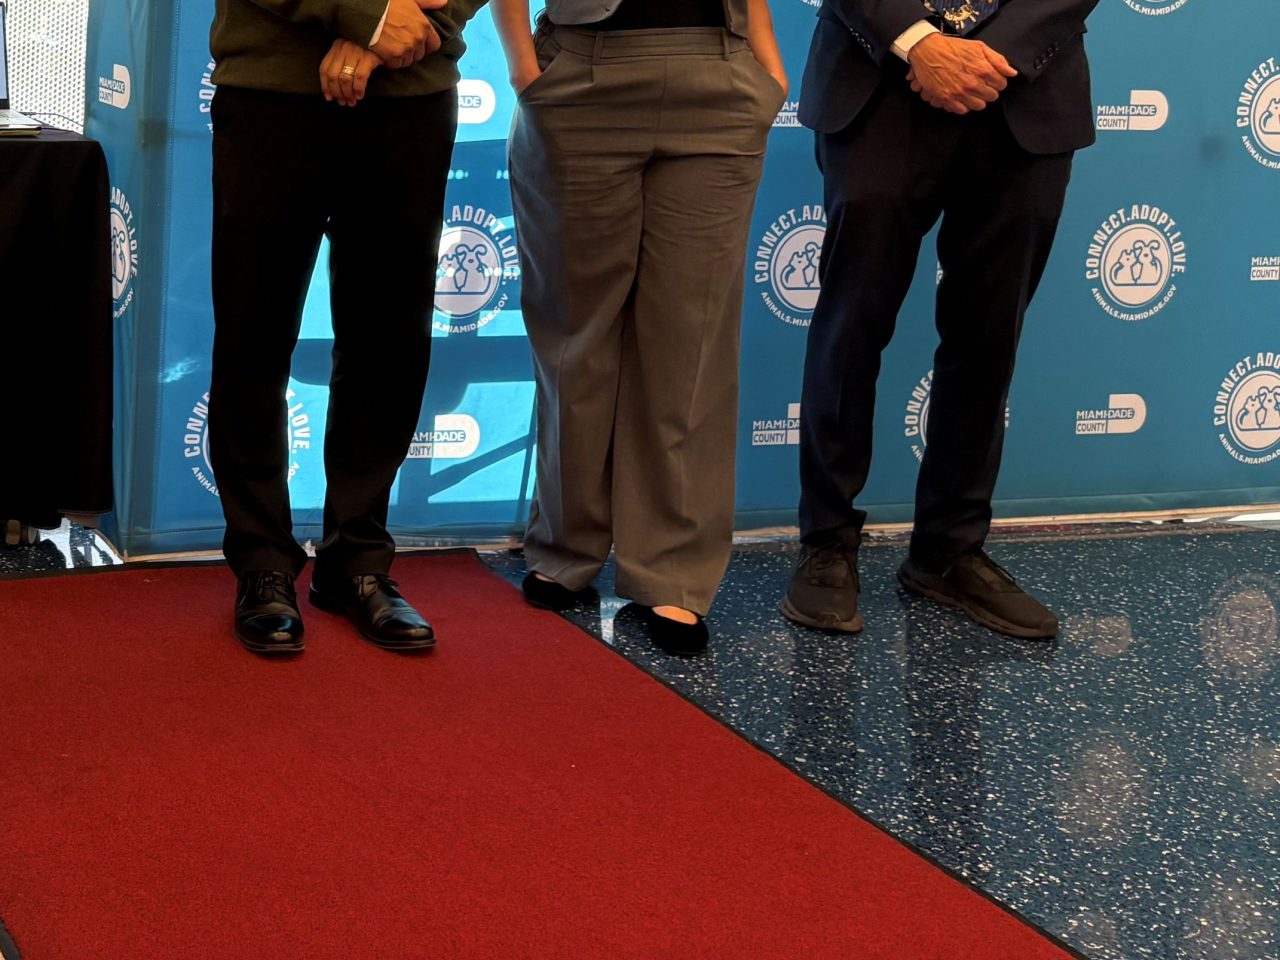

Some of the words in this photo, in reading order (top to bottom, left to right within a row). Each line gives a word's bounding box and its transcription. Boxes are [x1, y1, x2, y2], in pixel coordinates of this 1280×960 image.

[1097, 105, 1156, 115] MIAMI-DADE
[1097, 118, 1127, 128] COUNTY
[1250, 269, 1279, 279] COUNTY
[1091, 284, 1177, 321] ANIMALS.MIAMIDADE.GOV
[1076, 409, 1134, 420] MIAMI-DADE
[1076, 422, 1105, 432] COUNTY
[753, 433, 784, 443] COUNTY
